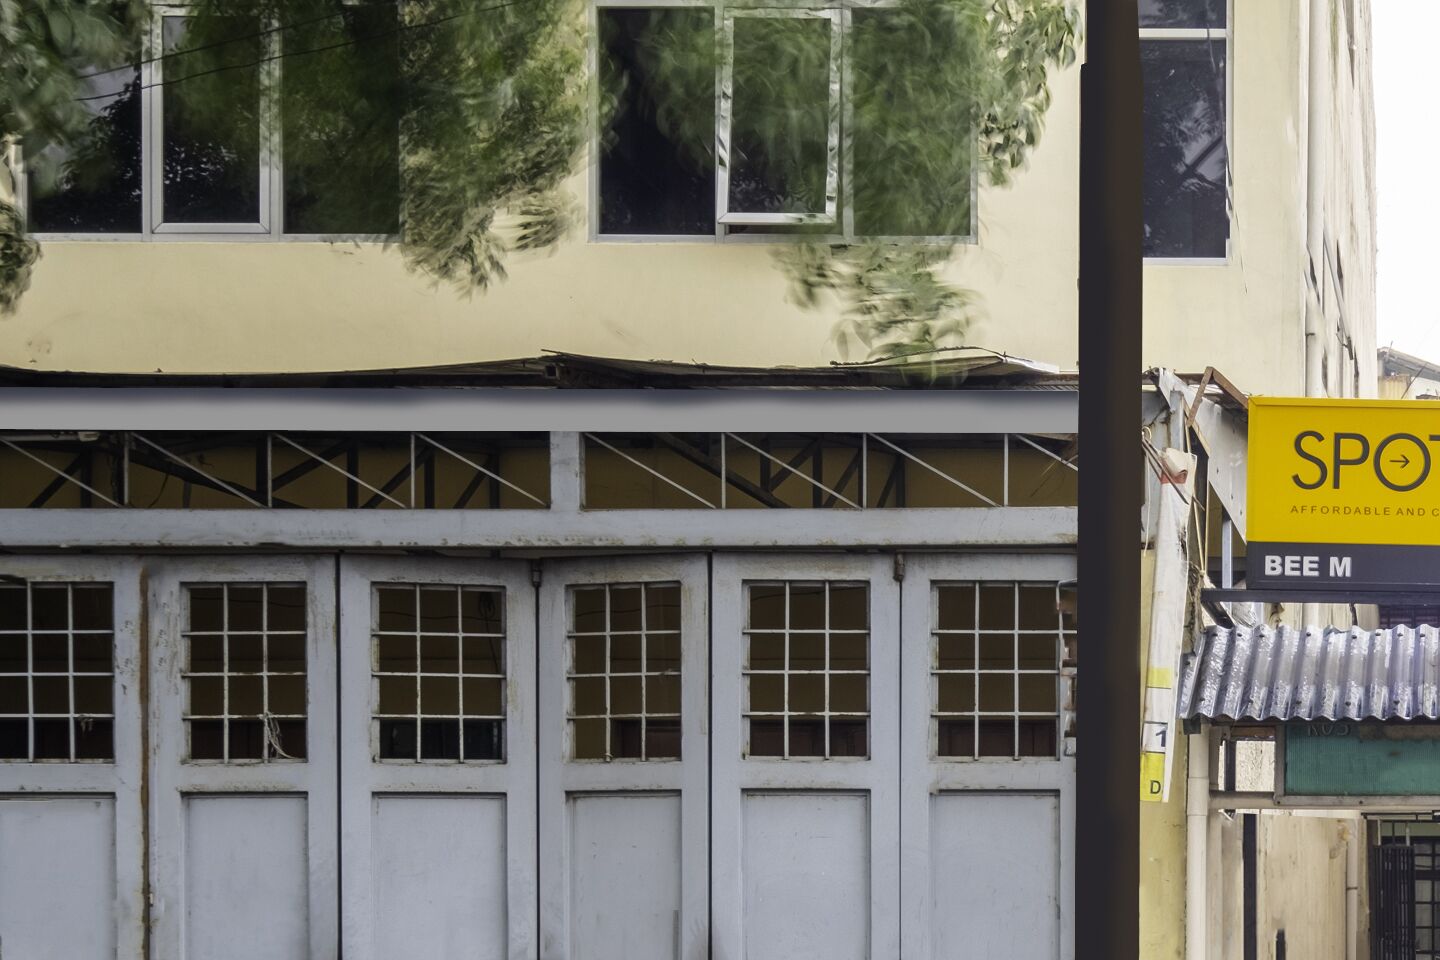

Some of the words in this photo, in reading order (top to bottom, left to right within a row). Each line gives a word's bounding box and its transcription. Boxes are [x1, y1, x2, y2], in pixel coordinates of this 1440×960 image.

[1290, 505, 1391, 516] AFFORDABLE
[1396, 507, 1426, 517] AND
[1264, 555, 1320, 577] BEE
[1329, 556, 1352, 578] M
